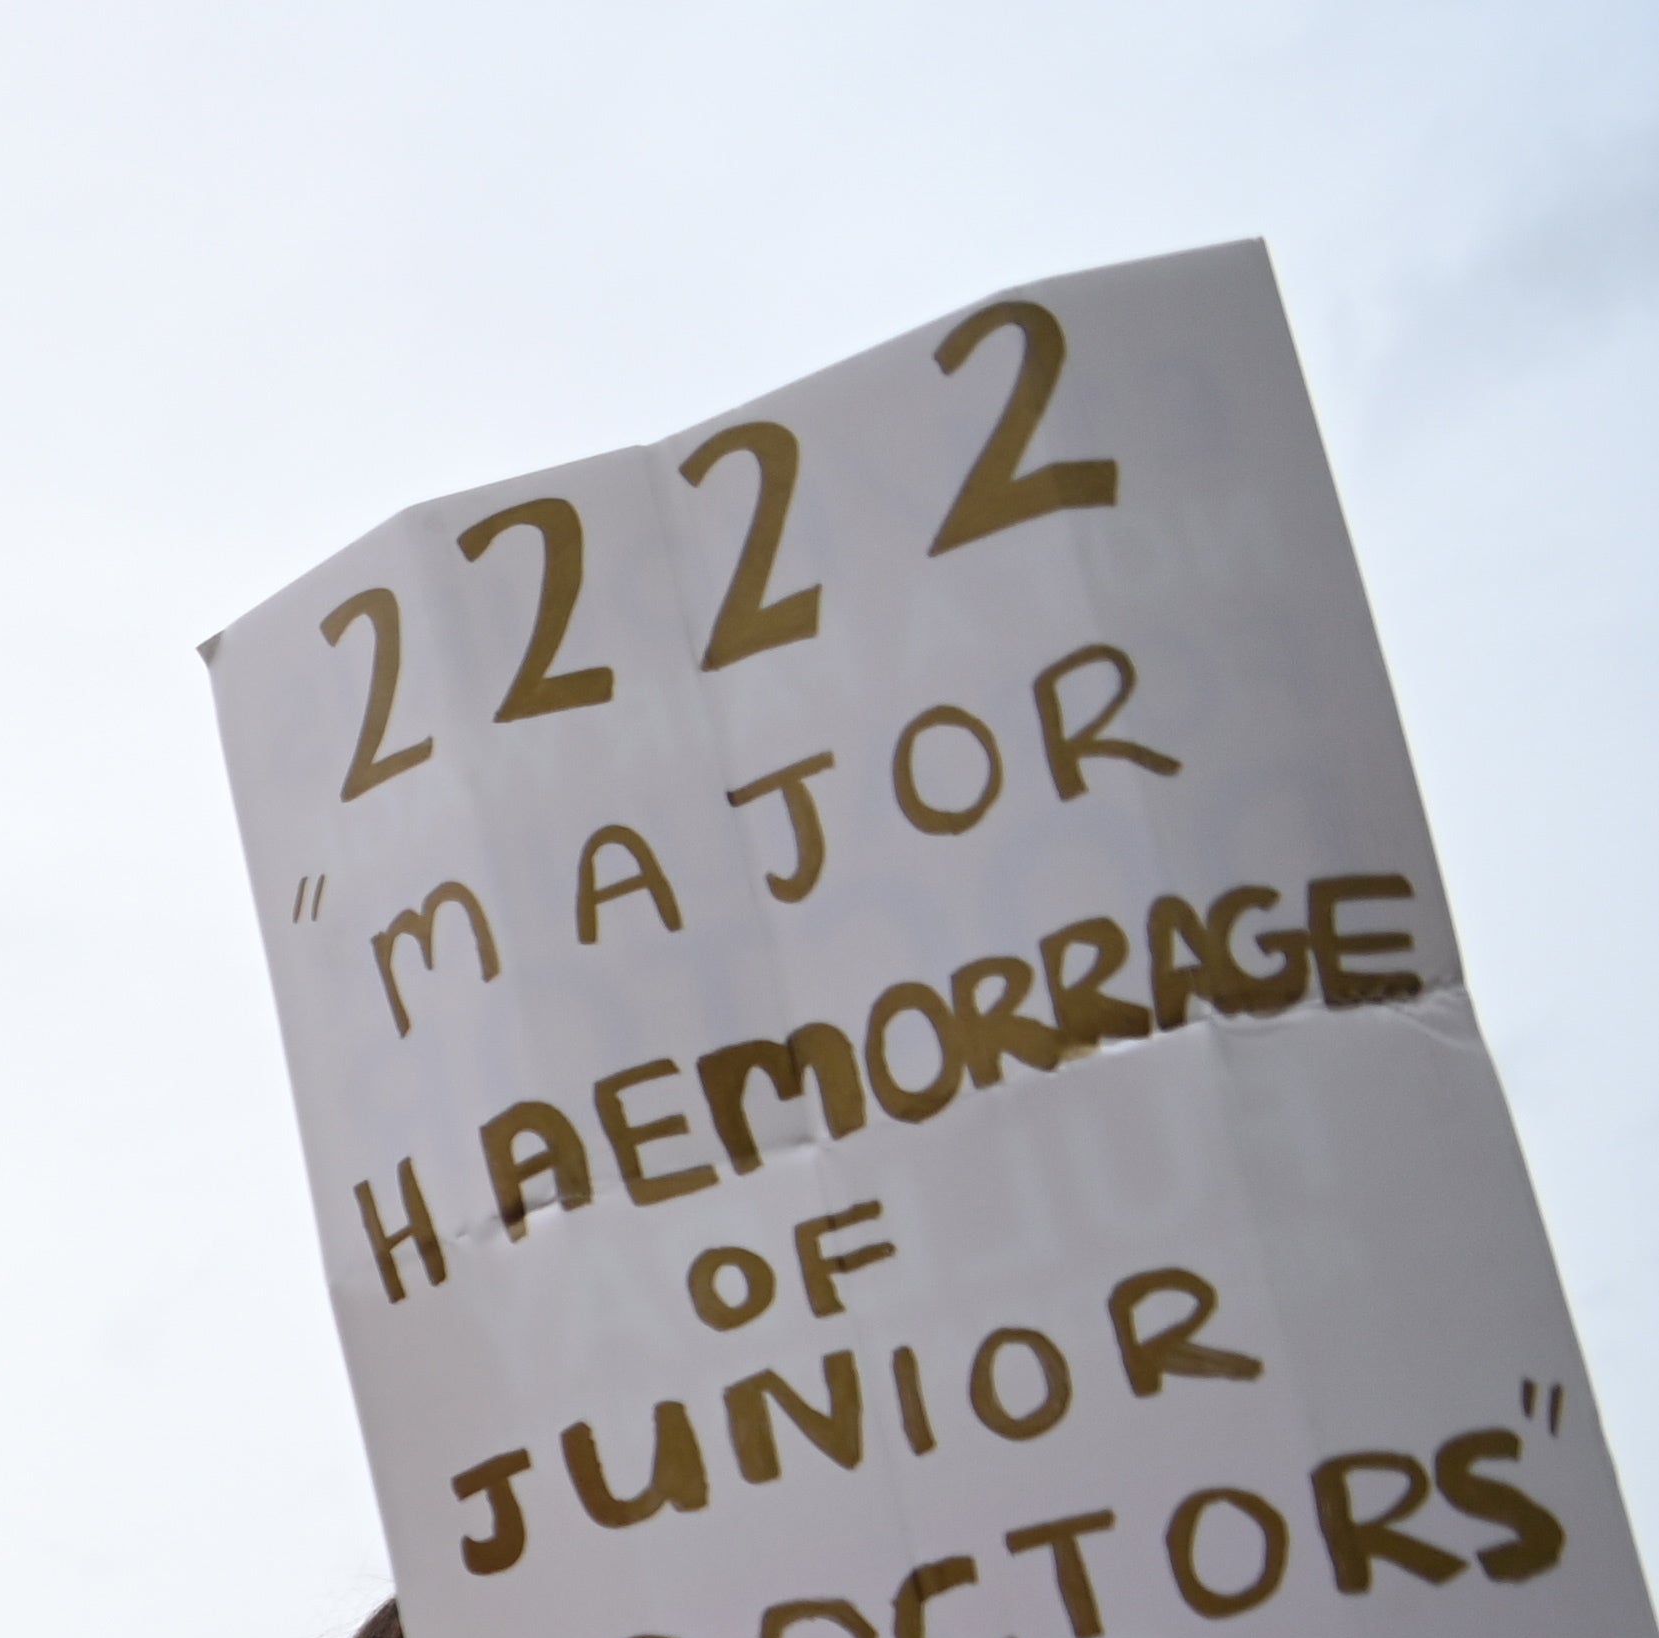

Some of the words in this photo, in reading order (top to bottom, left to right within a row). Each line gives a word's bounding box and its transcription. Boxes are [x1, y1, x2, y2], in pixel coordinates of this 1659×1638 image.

[354, 874, 1423, 1303] HAEMORRAGE
[687, 1201, 896, 1331] OF
[453, 1267, 1261, 1575] JUNIOR
